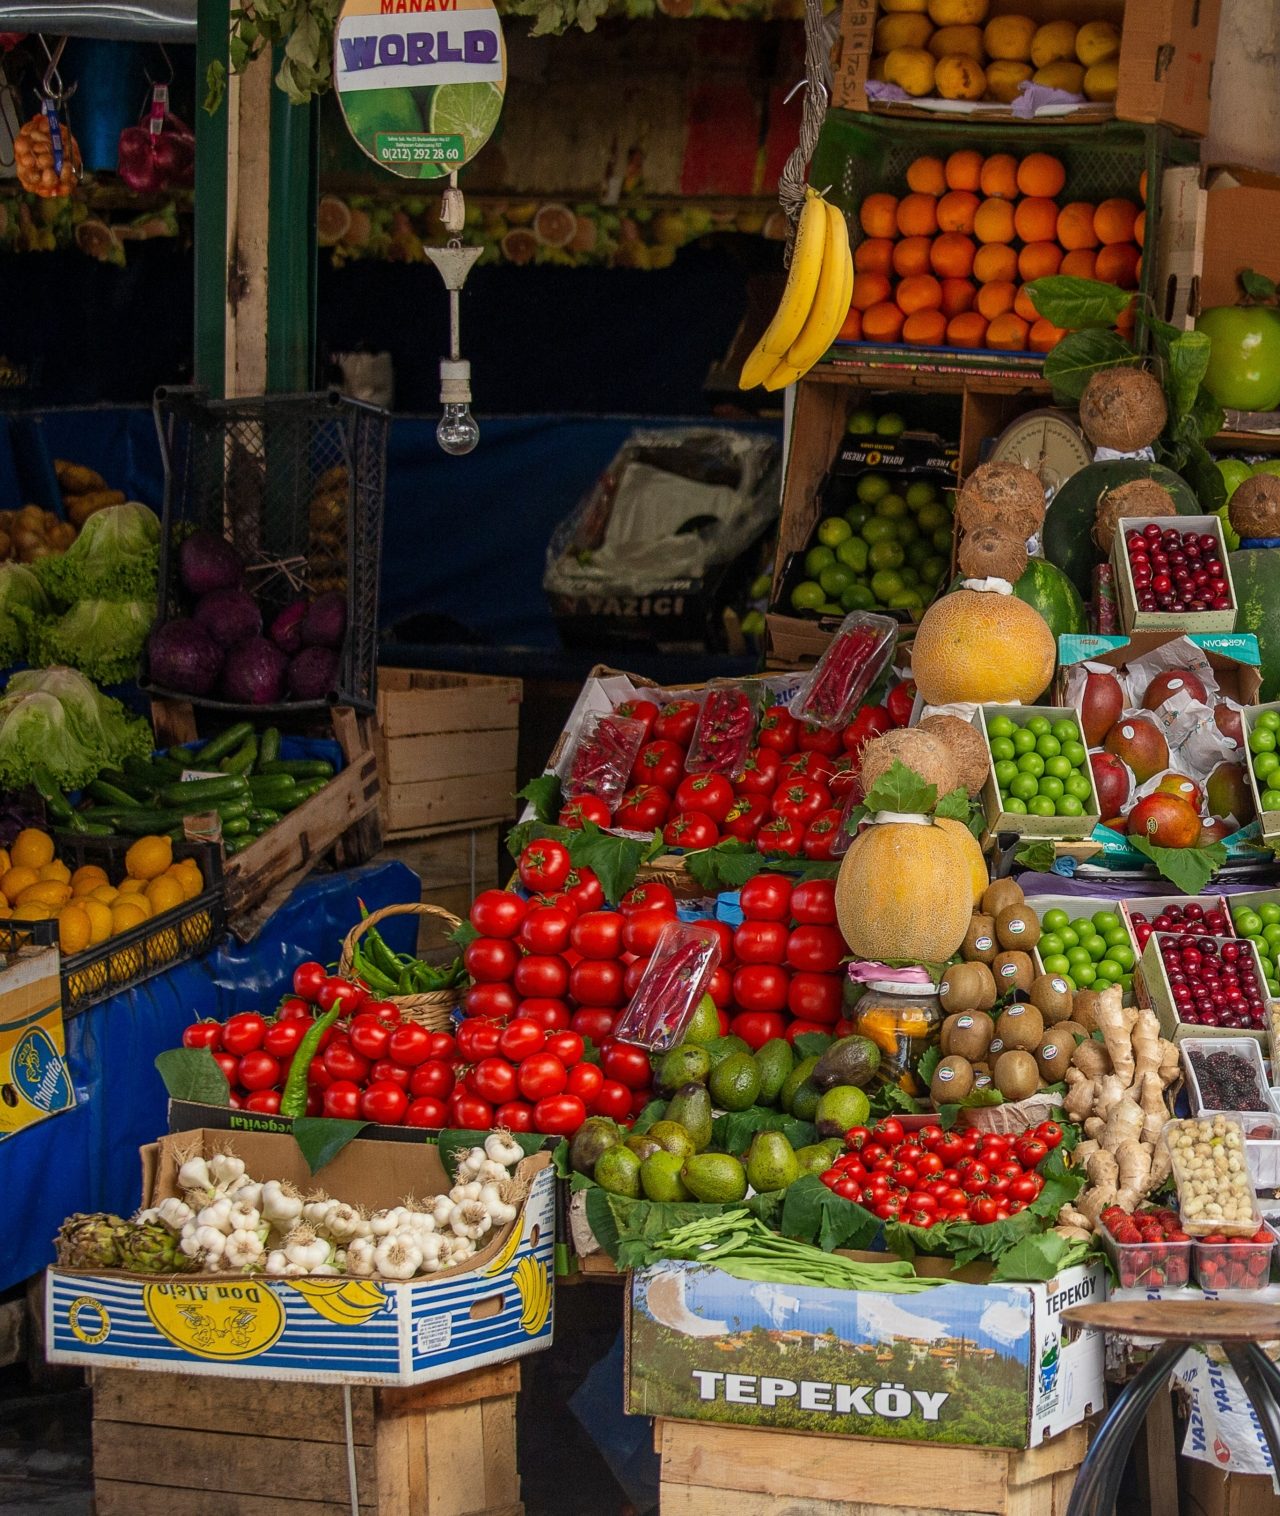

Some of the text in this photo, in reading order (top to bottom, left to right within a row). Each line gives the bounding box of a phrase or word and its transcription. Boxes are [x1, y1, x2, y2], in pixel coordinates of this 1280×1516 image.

[340, 30, 498, 72] WORLD
[382, 148, 459, 161] 0(212) 292 28 60
[842, 451, 867, 462] FRESH
[1203, 639, 1247, 648] AGRODAN
[1103, 842, 1134, 852] RODAN
[33, 1057, 62, 1111] Chiquita
[230, 1115, 293, 1135] vegevital
[216, 1287, 262, 1304] Don
[1046, 1275, 1097, 1316] TEPEKÖY
[692, 1369, 950, 1421] TEPEKÖY
